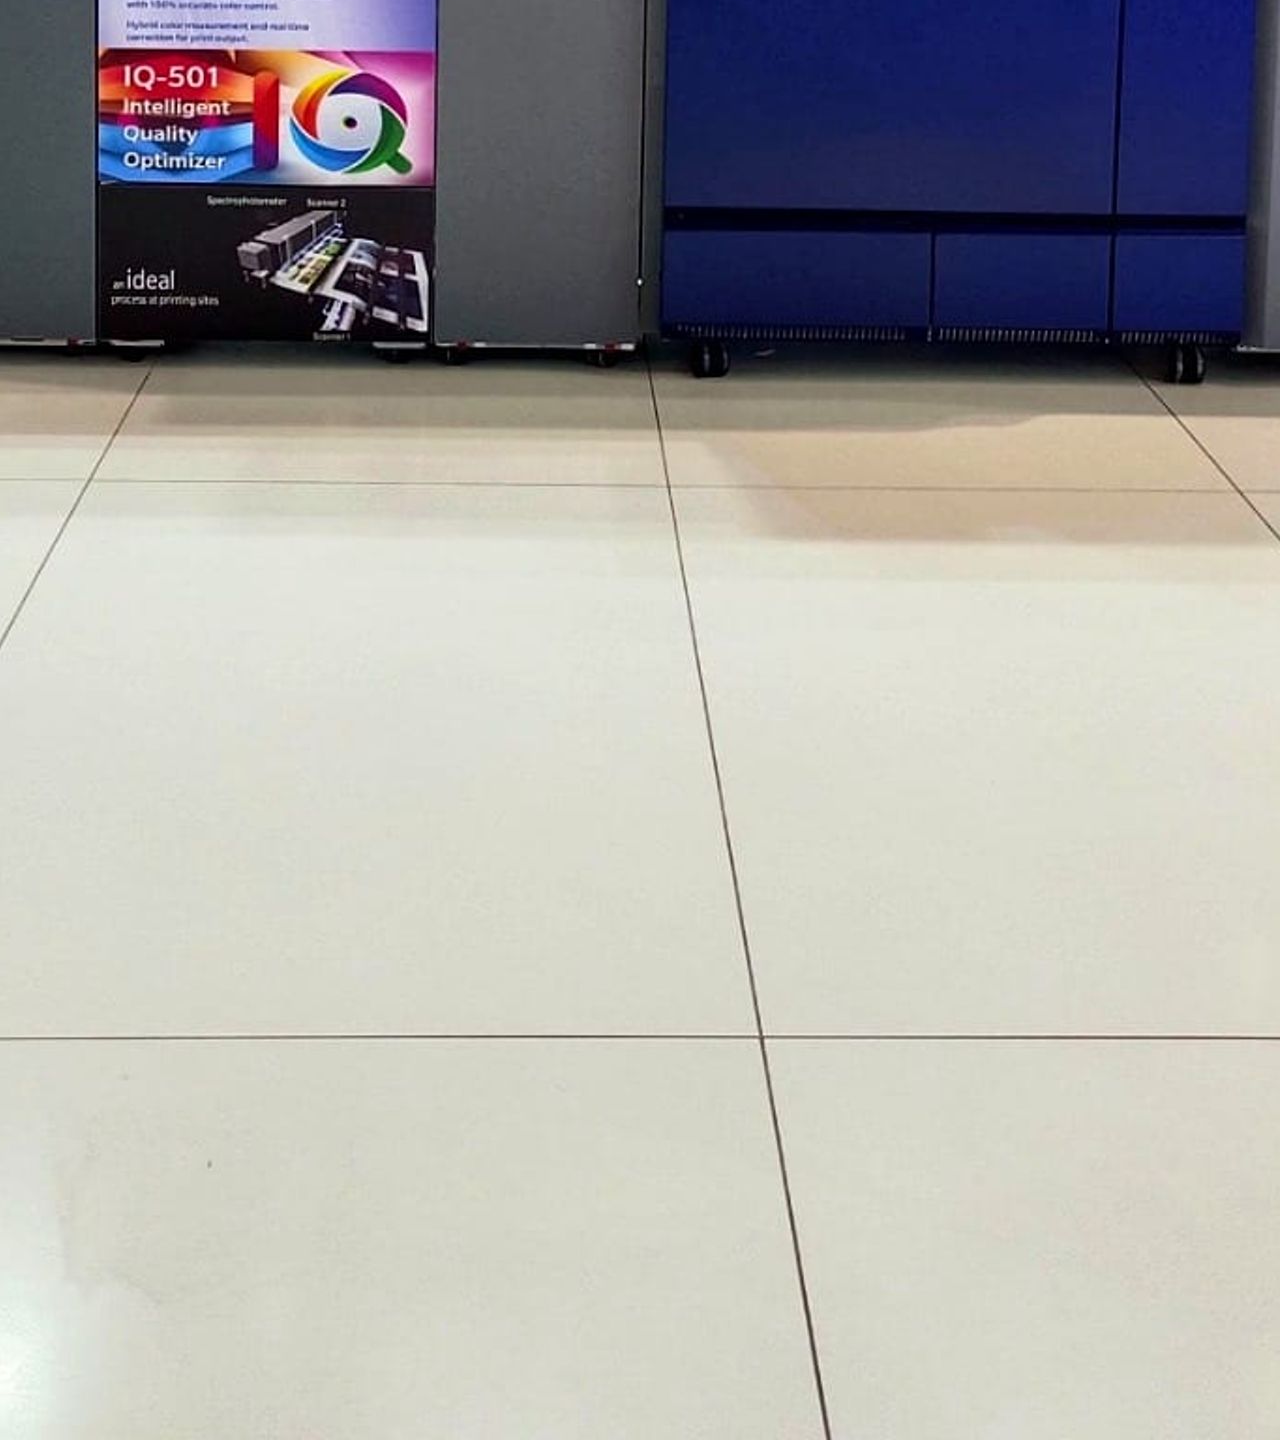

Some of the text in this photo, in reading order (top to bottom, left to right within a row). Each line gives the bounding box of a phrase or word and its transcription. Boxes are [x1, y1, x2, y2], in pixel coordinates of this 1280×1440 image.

[123, 65, 219, 89] IQ-501
[123, 99, 231, 118] Intelligent
[123, 125, 199, 145] Quality
[123, 151, 227, 172] Optimizer
[126, 267, 175, 291] ideal
[111, 295, 147, 306] process
[159, 295, 197, 307] printing
